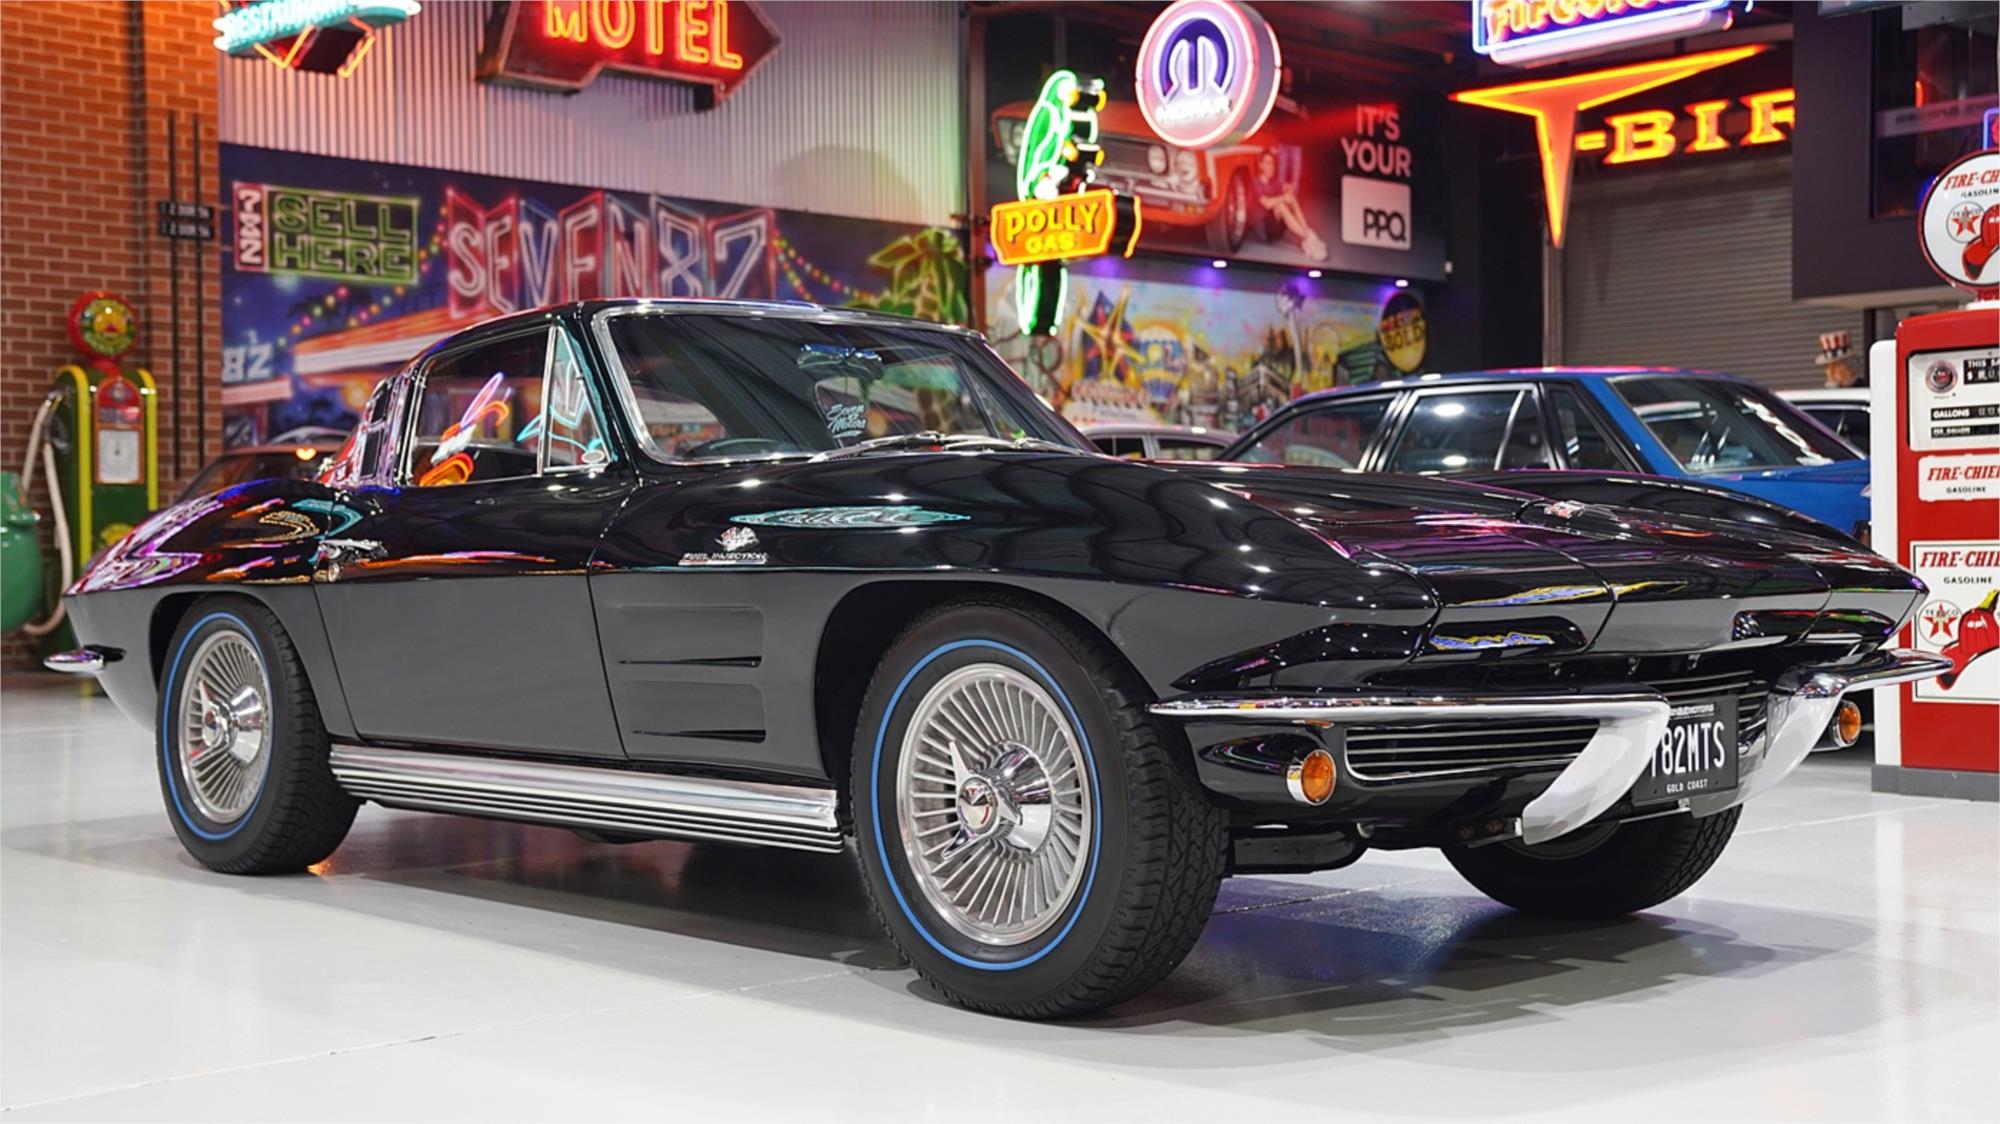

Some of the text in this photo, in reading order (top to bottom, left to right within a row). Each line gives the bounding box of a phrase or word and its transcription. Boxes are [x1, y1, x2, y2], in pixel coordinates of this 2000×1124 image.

[546, 0, 743, 69] MOTEL
[1356, 105, 1400, 141] IT'S
[1341, 137, 1411, 177] YOUR
[274, 193, 411, 243] SELL
[1004, 202, 1099, 242] POLLY
[1363, 207, 1406, 242] PPQ
[274, 232, 411, 281] HERE
[1025, 232, 1075, 254] GAS
[1933, 409, 1970, 418] GALLONS
[1943, 576, 1993, 584] GASOLINE
[1667, 783, 1684, 793] GOLD
